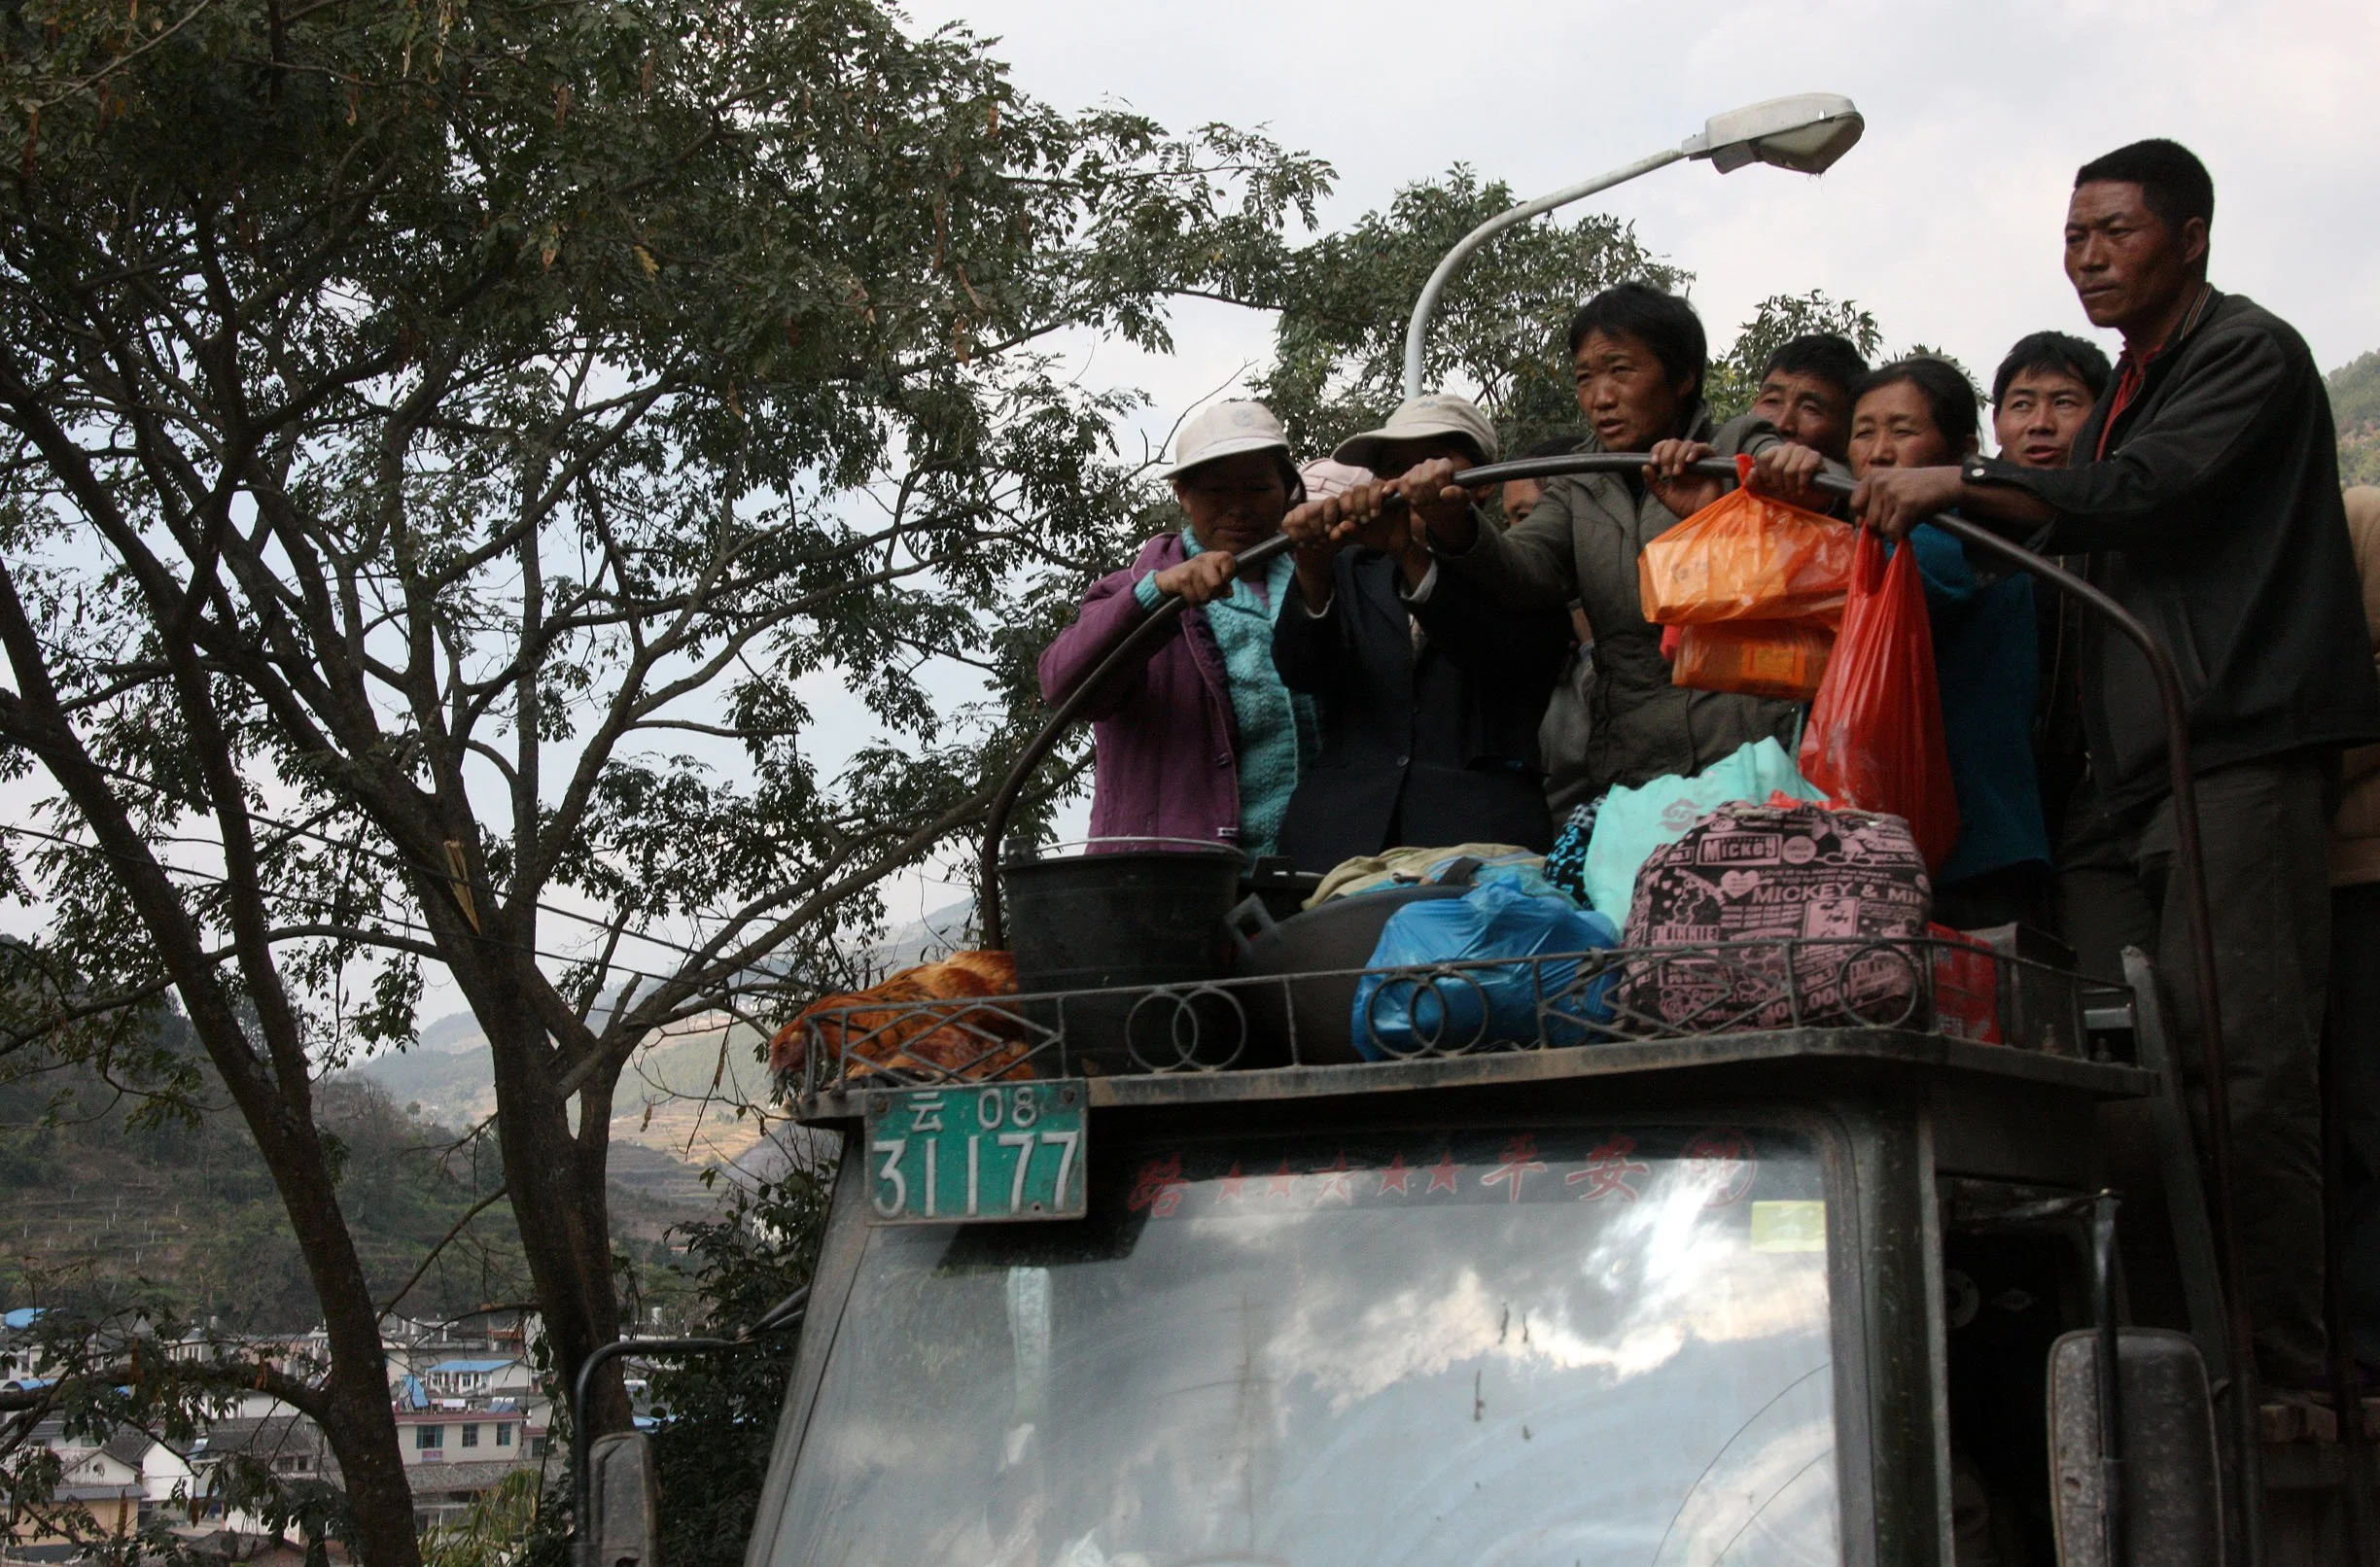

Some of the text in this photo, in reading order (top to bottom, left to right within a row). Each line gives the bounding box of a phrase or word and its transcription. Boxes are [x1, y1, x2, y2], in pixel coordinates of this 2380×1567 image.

[1703, 836, 1777, 863] Mickey
[1751, 883, 1854, 904] MICKEY
[909, 1087, 1037, 1132] 云 08
[872, 1131, 1079, 1218] 31177
[1480, 1132, 1650, 1203] 平安
